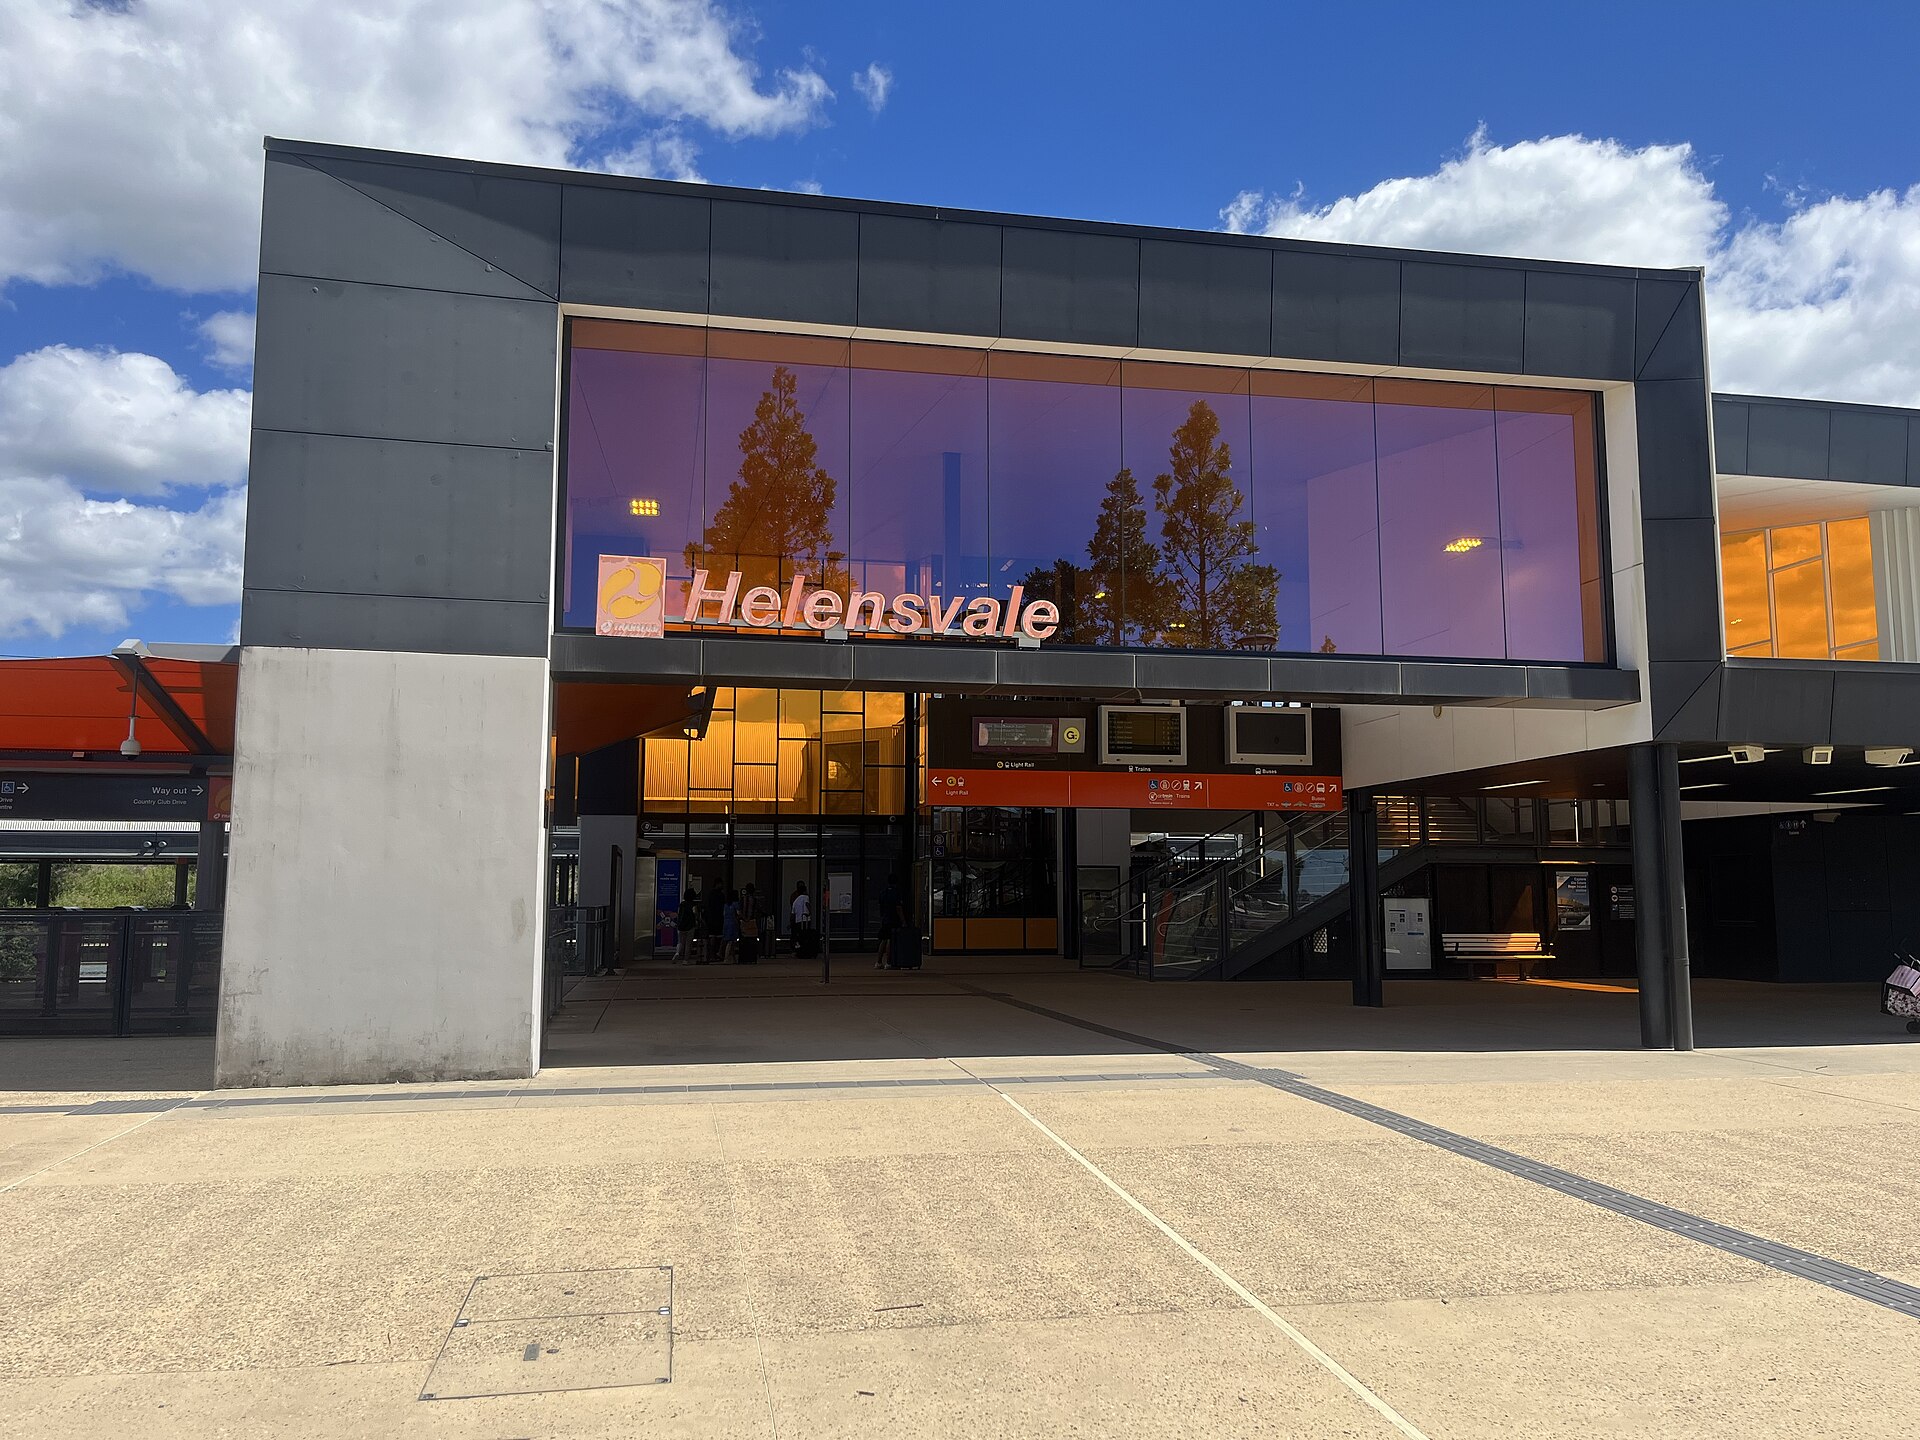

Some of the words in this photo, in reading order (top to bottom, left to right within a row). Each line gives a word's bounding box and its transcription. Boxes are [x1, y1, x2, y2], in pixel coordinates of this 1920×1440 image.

[684, 569, 1060, 640] Helensvale
[1010, 762, 1024, 770] Light
[152, 786, 171, 796] Way
[173, 787, 187, 795] out
[133, 798, 156, 806] Country
